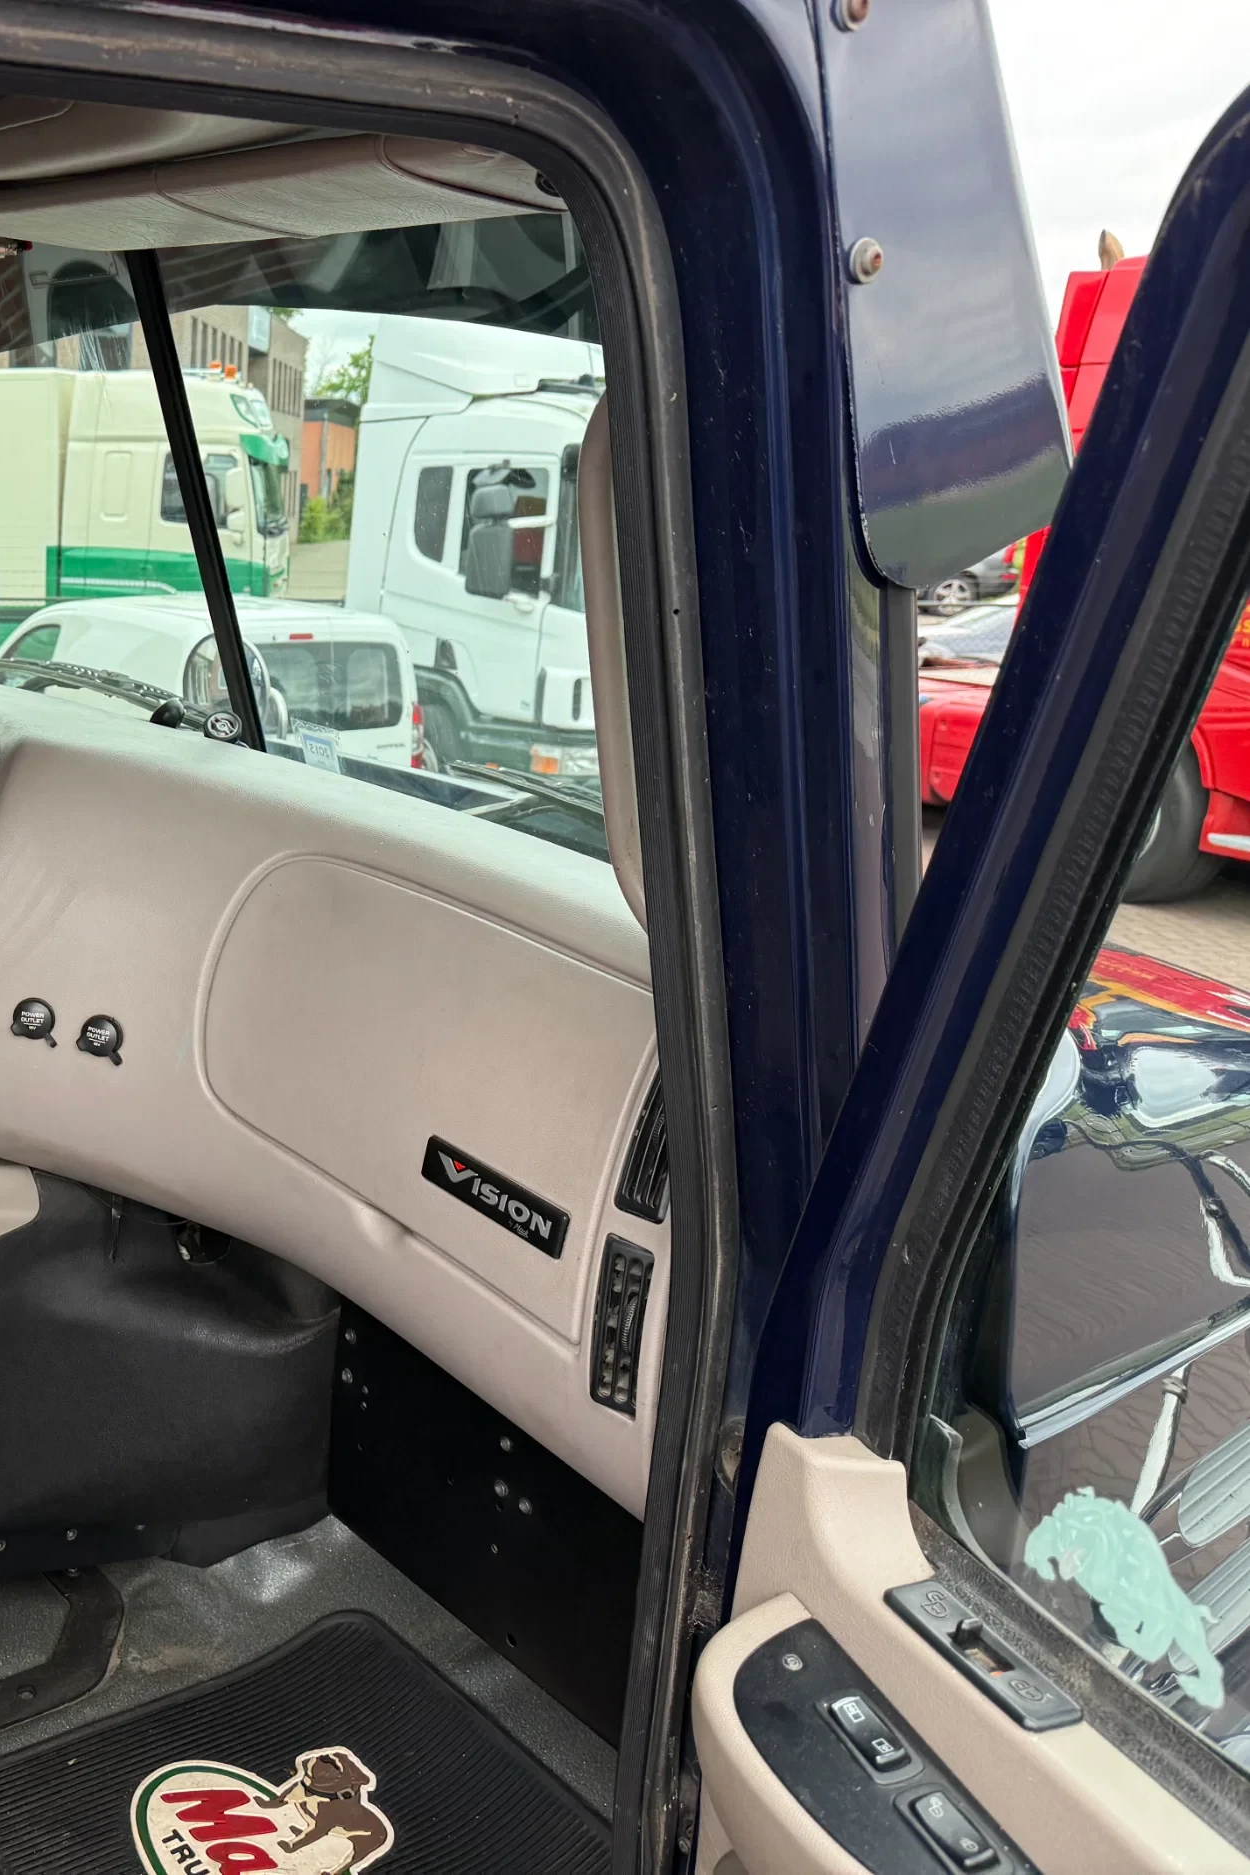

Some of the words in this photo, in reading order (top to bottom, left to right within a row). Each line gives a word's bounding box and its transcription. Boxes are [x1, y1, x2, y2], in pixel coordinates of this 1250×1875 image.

[86, 1032, 110, 1042] OUTLET
[87, 1026, 110, 1036] POWER
[437, 1150, 553, 1240] VISION
[513, 1222, 529, 1238] Mack
